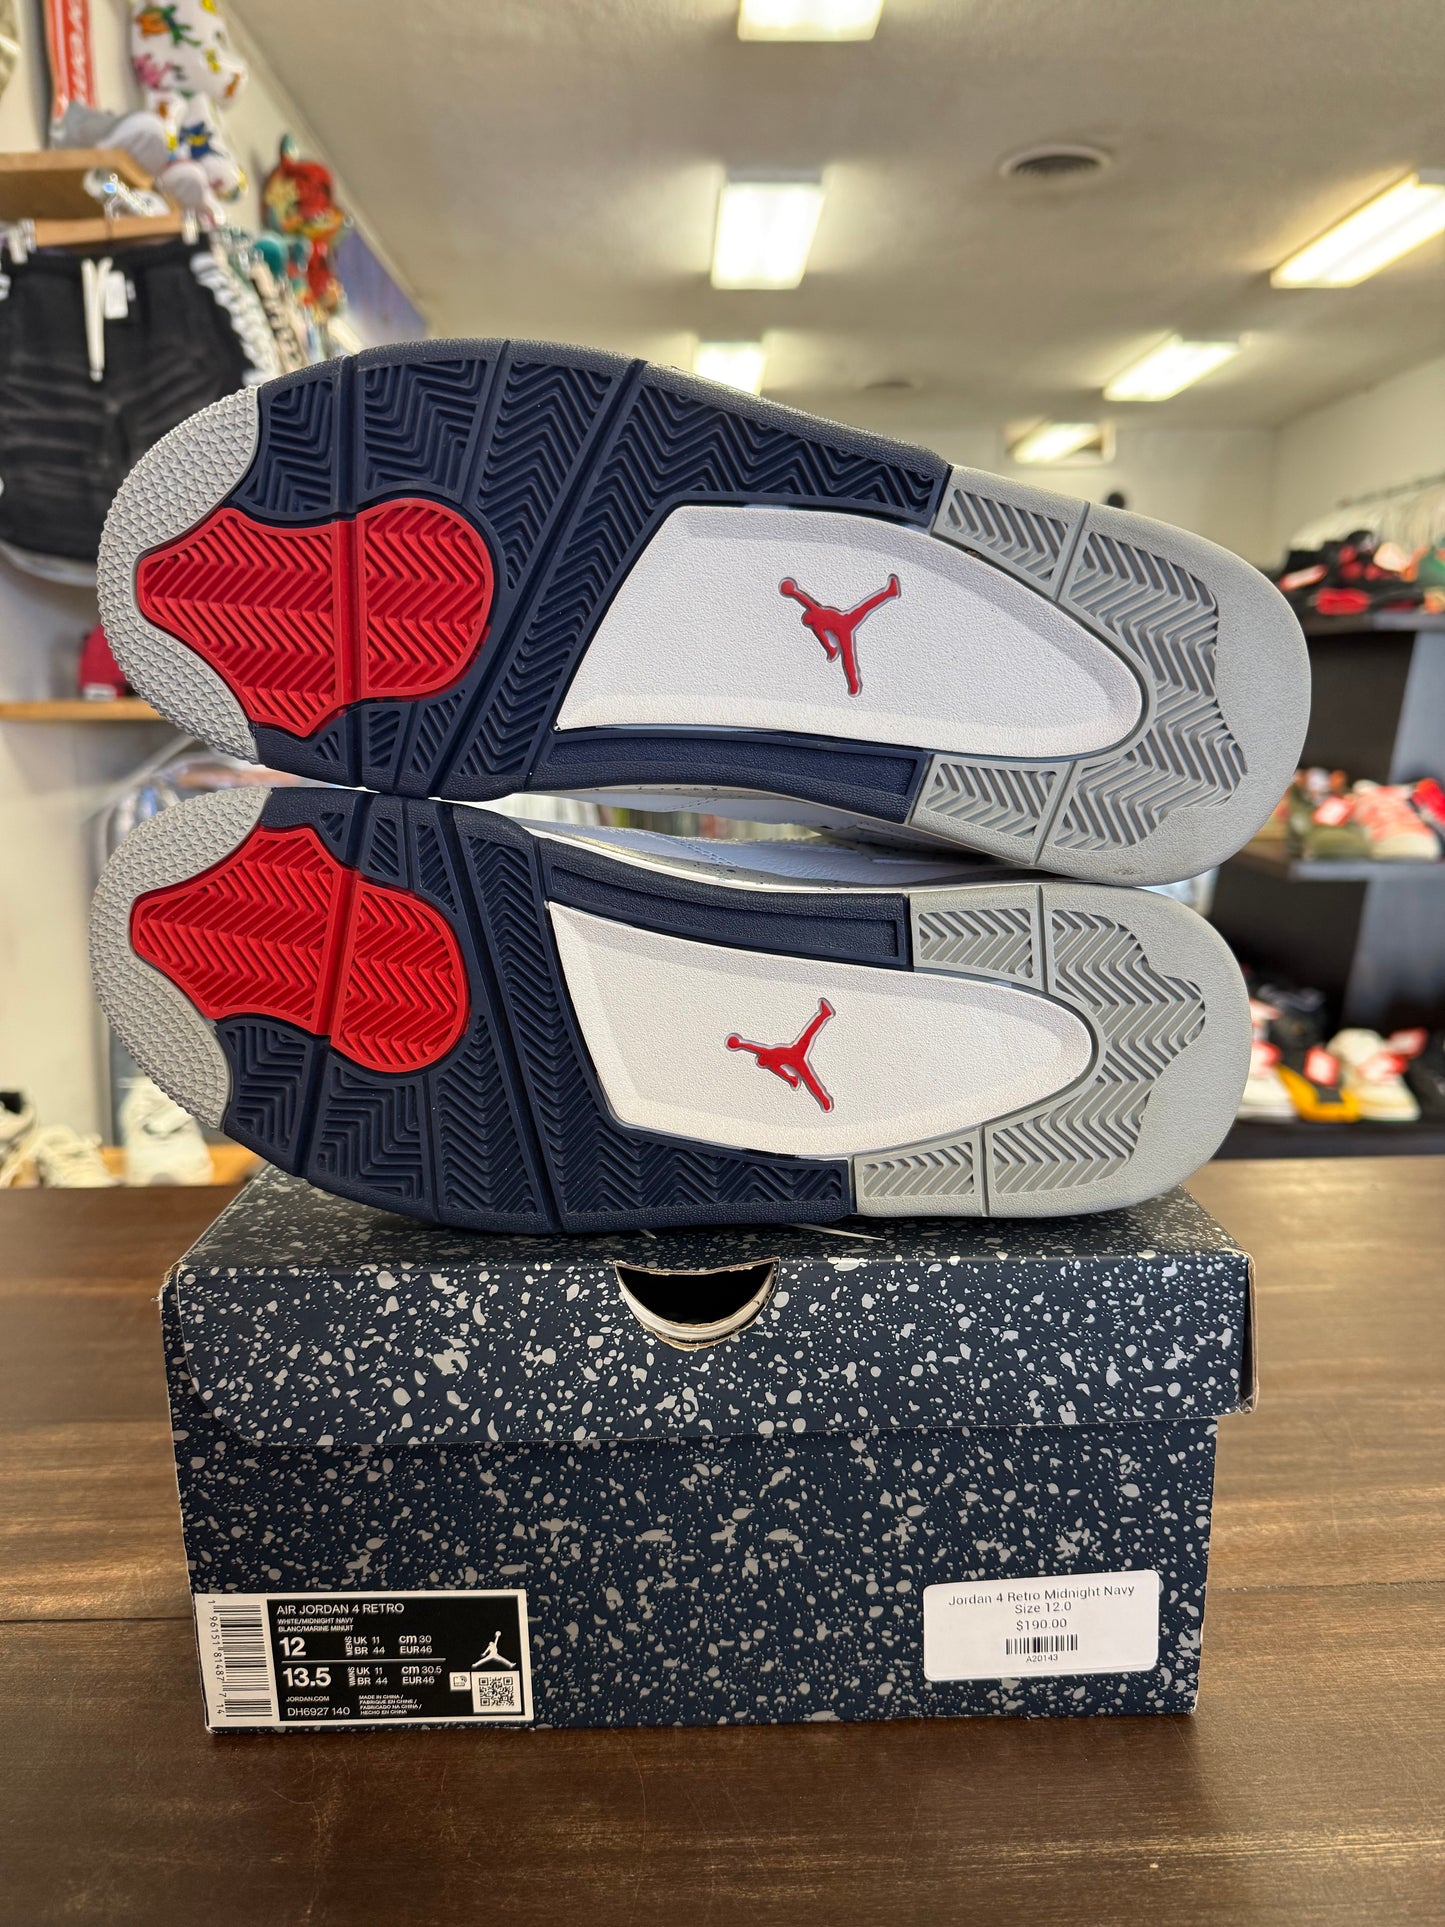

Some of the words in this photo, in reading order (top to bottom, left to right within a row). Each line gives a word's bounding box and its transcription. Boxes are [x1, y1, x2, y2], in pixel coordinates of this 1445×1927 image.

[949, 1593, 992, 1606] Jordan
[996, 1593, 1003, 1602] 4
[1007, 1591, 1040, 1602] Retro
[1044, 1586, 1101, 1601] Midnight
[1104, 1584, 1135, 1597] Navy
[276, 1605, 296, 1615] AIR
[299, 1604, 349, 1614] JORDAN
[352, 1604, 359, 1613] 4
[362, 1603, 405, 1613] RETRO
[1014, 1603, 1041, 1614] Size
[1045, 1601, 1072, 1613] 12.0
[209, 1615, 221, 1645] 96151
[1016, 1618, 1067, 1632] $190.00
[354, 1636, 367, 1645] UK
[372, 1636, 380, 1644] 11
[398, 1635, 417, 1644] cm
[419, 1635, 432, 1643] 30
[279, 1637, 307, 1657] 12
[344, 1636, 353, 1656] MENS
[354, 1646, 368, 1655] BR
[372, 1646, 385, 1655] 44
[1026, 1653, 1058, 1663] A20143
[213, 1652, 225, 1682] 81487
[356, 1667, 370, 1676] UK
[374, 1667, 382, 1675] 11
[401, 1666, 420, 1675] cm
[421, 1666, 442, 1674] 30.5
[282, 1667, 332, 1687] 13.5
[357, 1677, 371, 1686] BR
[375, 1677, 388, 1686] 44
[287, 1707, 329, 1717] DH6927
[332, 1706, 350, 1716] 140
